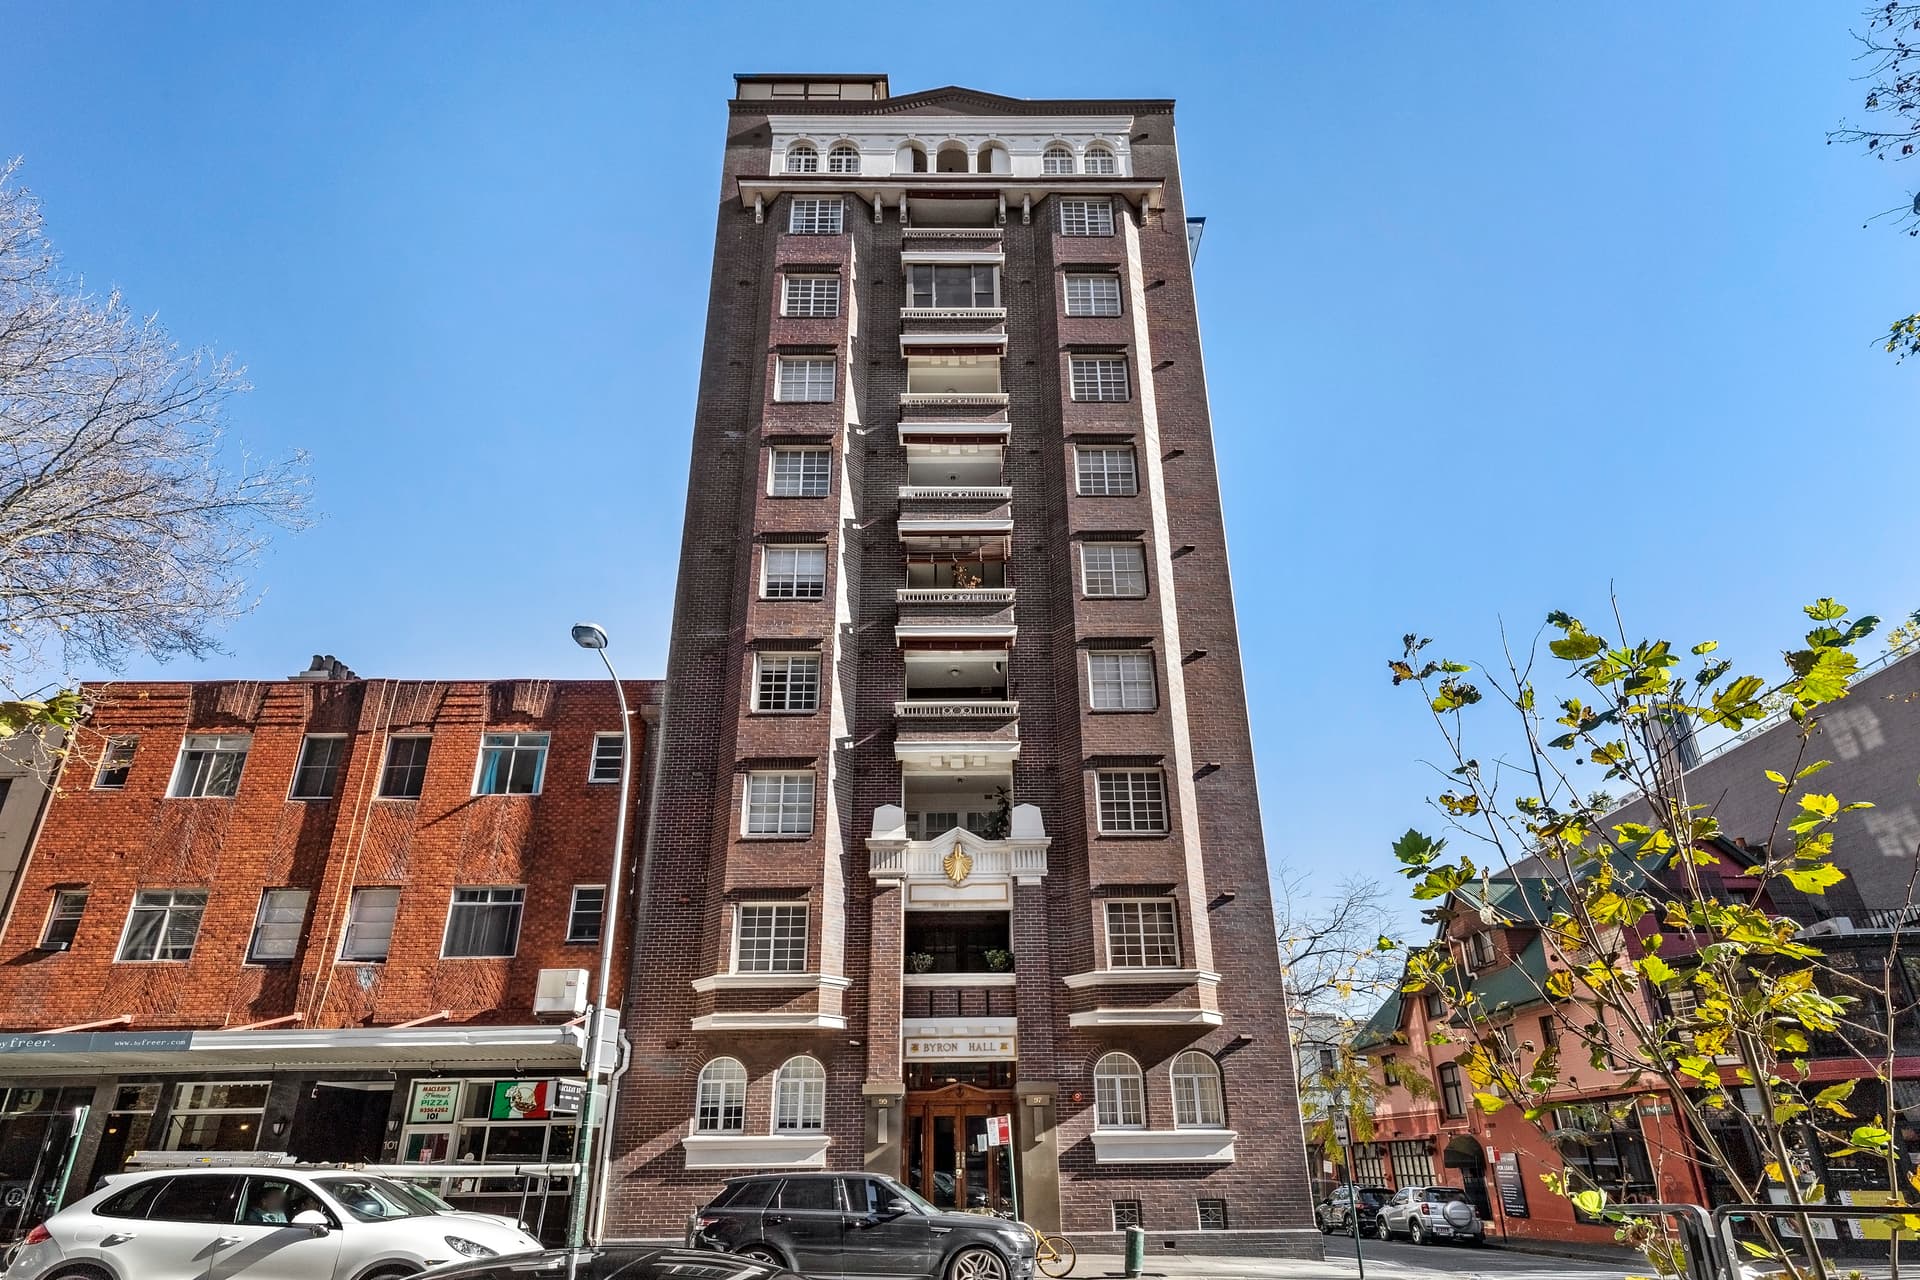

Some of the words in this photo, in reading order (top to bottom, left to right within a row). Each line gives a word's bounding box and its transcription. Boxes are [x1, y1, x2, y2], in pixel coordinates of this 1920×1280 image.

[923, 1042, 958, 1052] BYRON
[968, 1042, 997, 1052] HALL
[384, 1141, 398, 1150] 101
